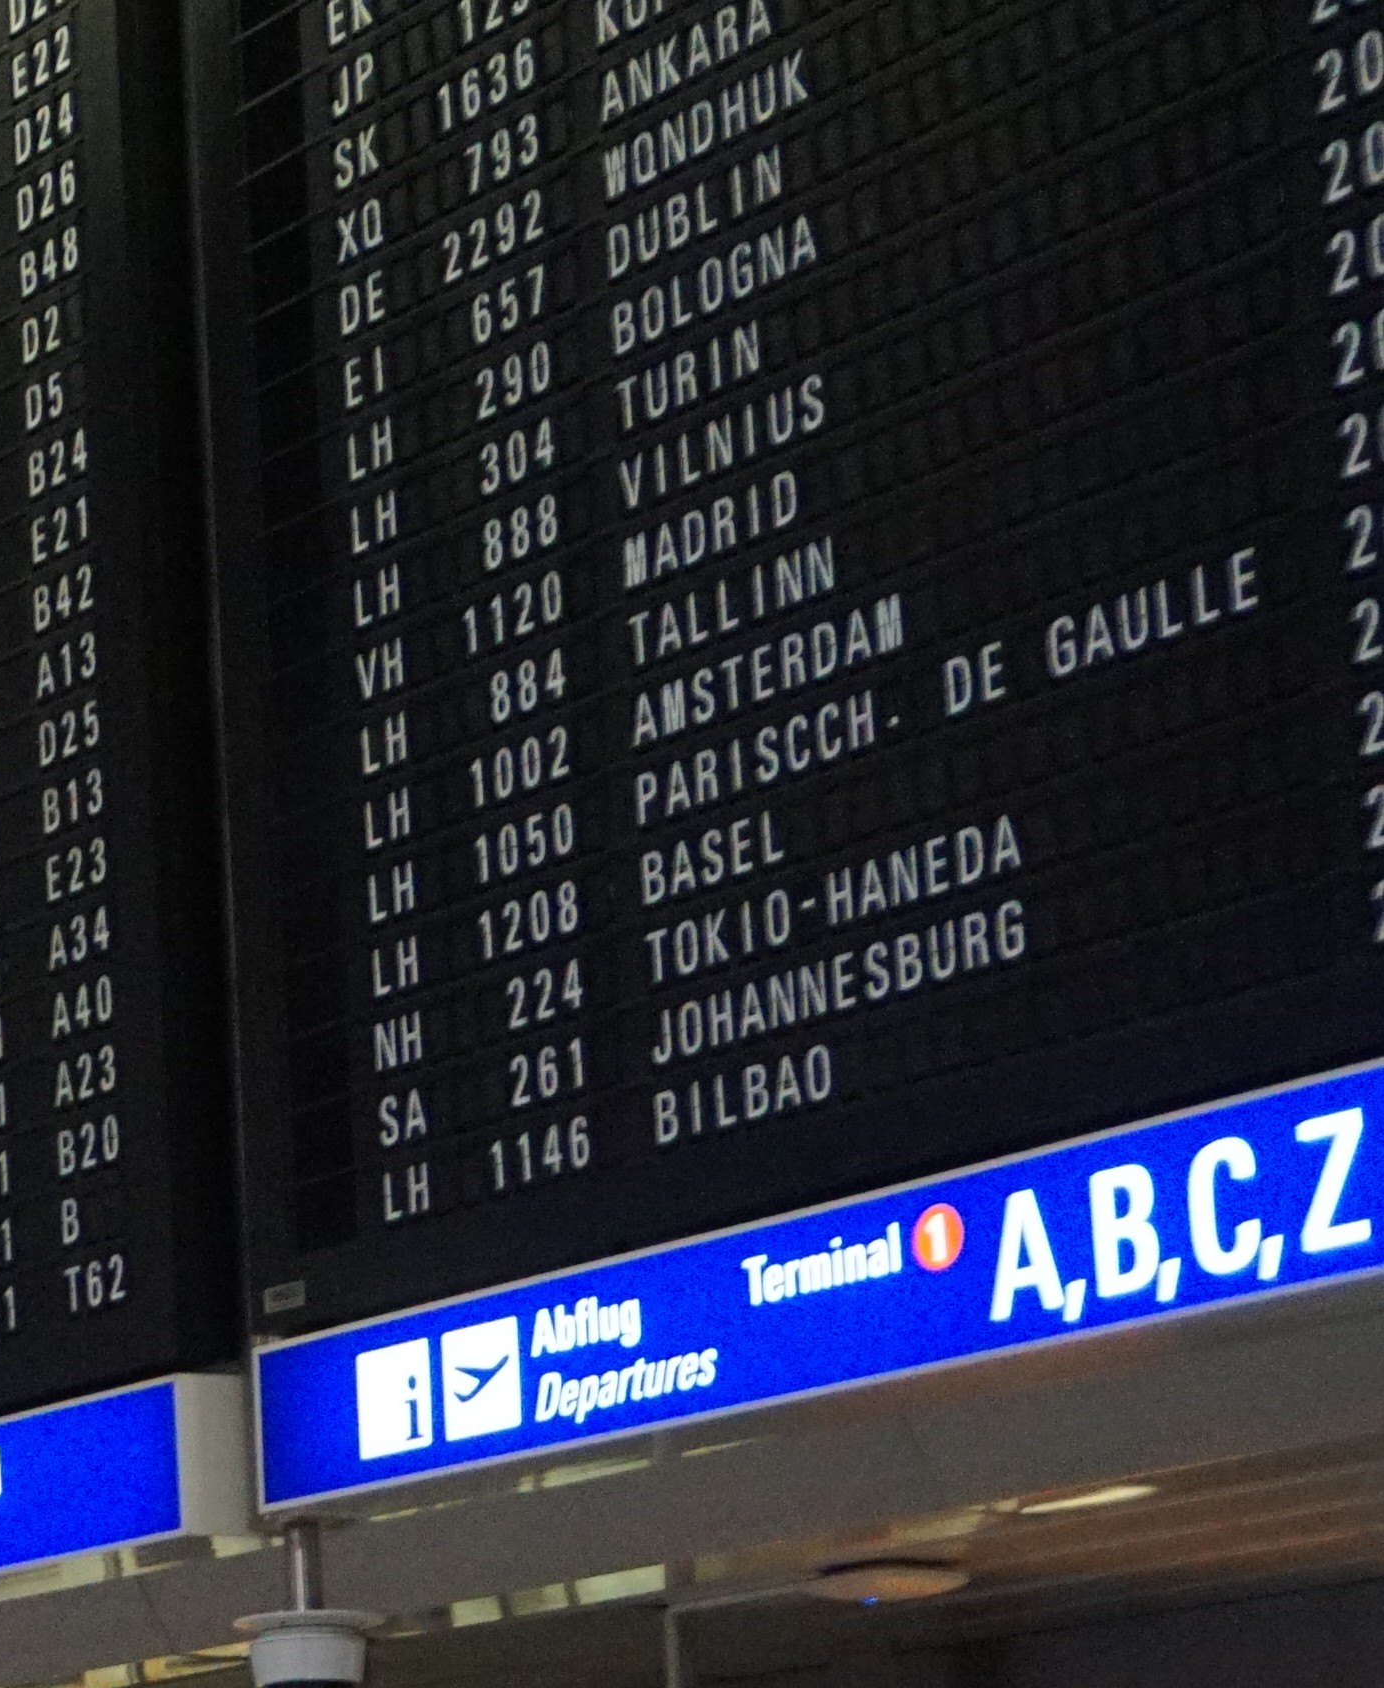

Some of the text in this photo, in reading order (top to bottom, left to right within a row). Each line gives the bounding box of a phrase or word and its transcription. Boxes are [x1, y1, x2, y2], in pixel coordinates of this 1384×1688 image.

[16, 159, 75, 232] D26
[338, 0, 771, 263] XQ 793 ANKARA
[438, 38, 534, 130] 1636
[339, 270, 385, 335] DE
[443, 189, 543, 283] 2292
[344, 145, 781, 409] EI 657 DUBLIN
[348, 215, 816, 481] LH 290 BOLOGNA
[351, 320, 760, 554] LH 304 TURIN
[354, 374, 824, 627] LH 888 VILNIUS
[356, 470, 797, 700] VH 1120 MADRID
[361, 536, 834, 775] LH 884 TALLINN
[364, 593, 903, 849] LH 1002 AMSTERDAM
[368, 860, 415, 923] LH
[475, 803, 573, 883] 1050
[943, 641, 1006, 716] DE
[1046, 547, 1258, 677] GAULLE
[372, 811, 784, 998] LH 1208 BASEL
[374, 815, 1021, 1071] NH 224 TOKIO-HANEDA
[379, 900, 1025, 1147] SA 261 JOHANNESBURG
[383, 1044, 831, 1222] LH 1146 BILBAO
[530, 1297, 643, 1358] Abflug
[742, 1222, 903, 1308] Terminal
[988, 1106, 1373, 1322] A,B,C,Z
[64, 1254, 126, 1312] T62
[535, 1348, 718, 1424] Departures
